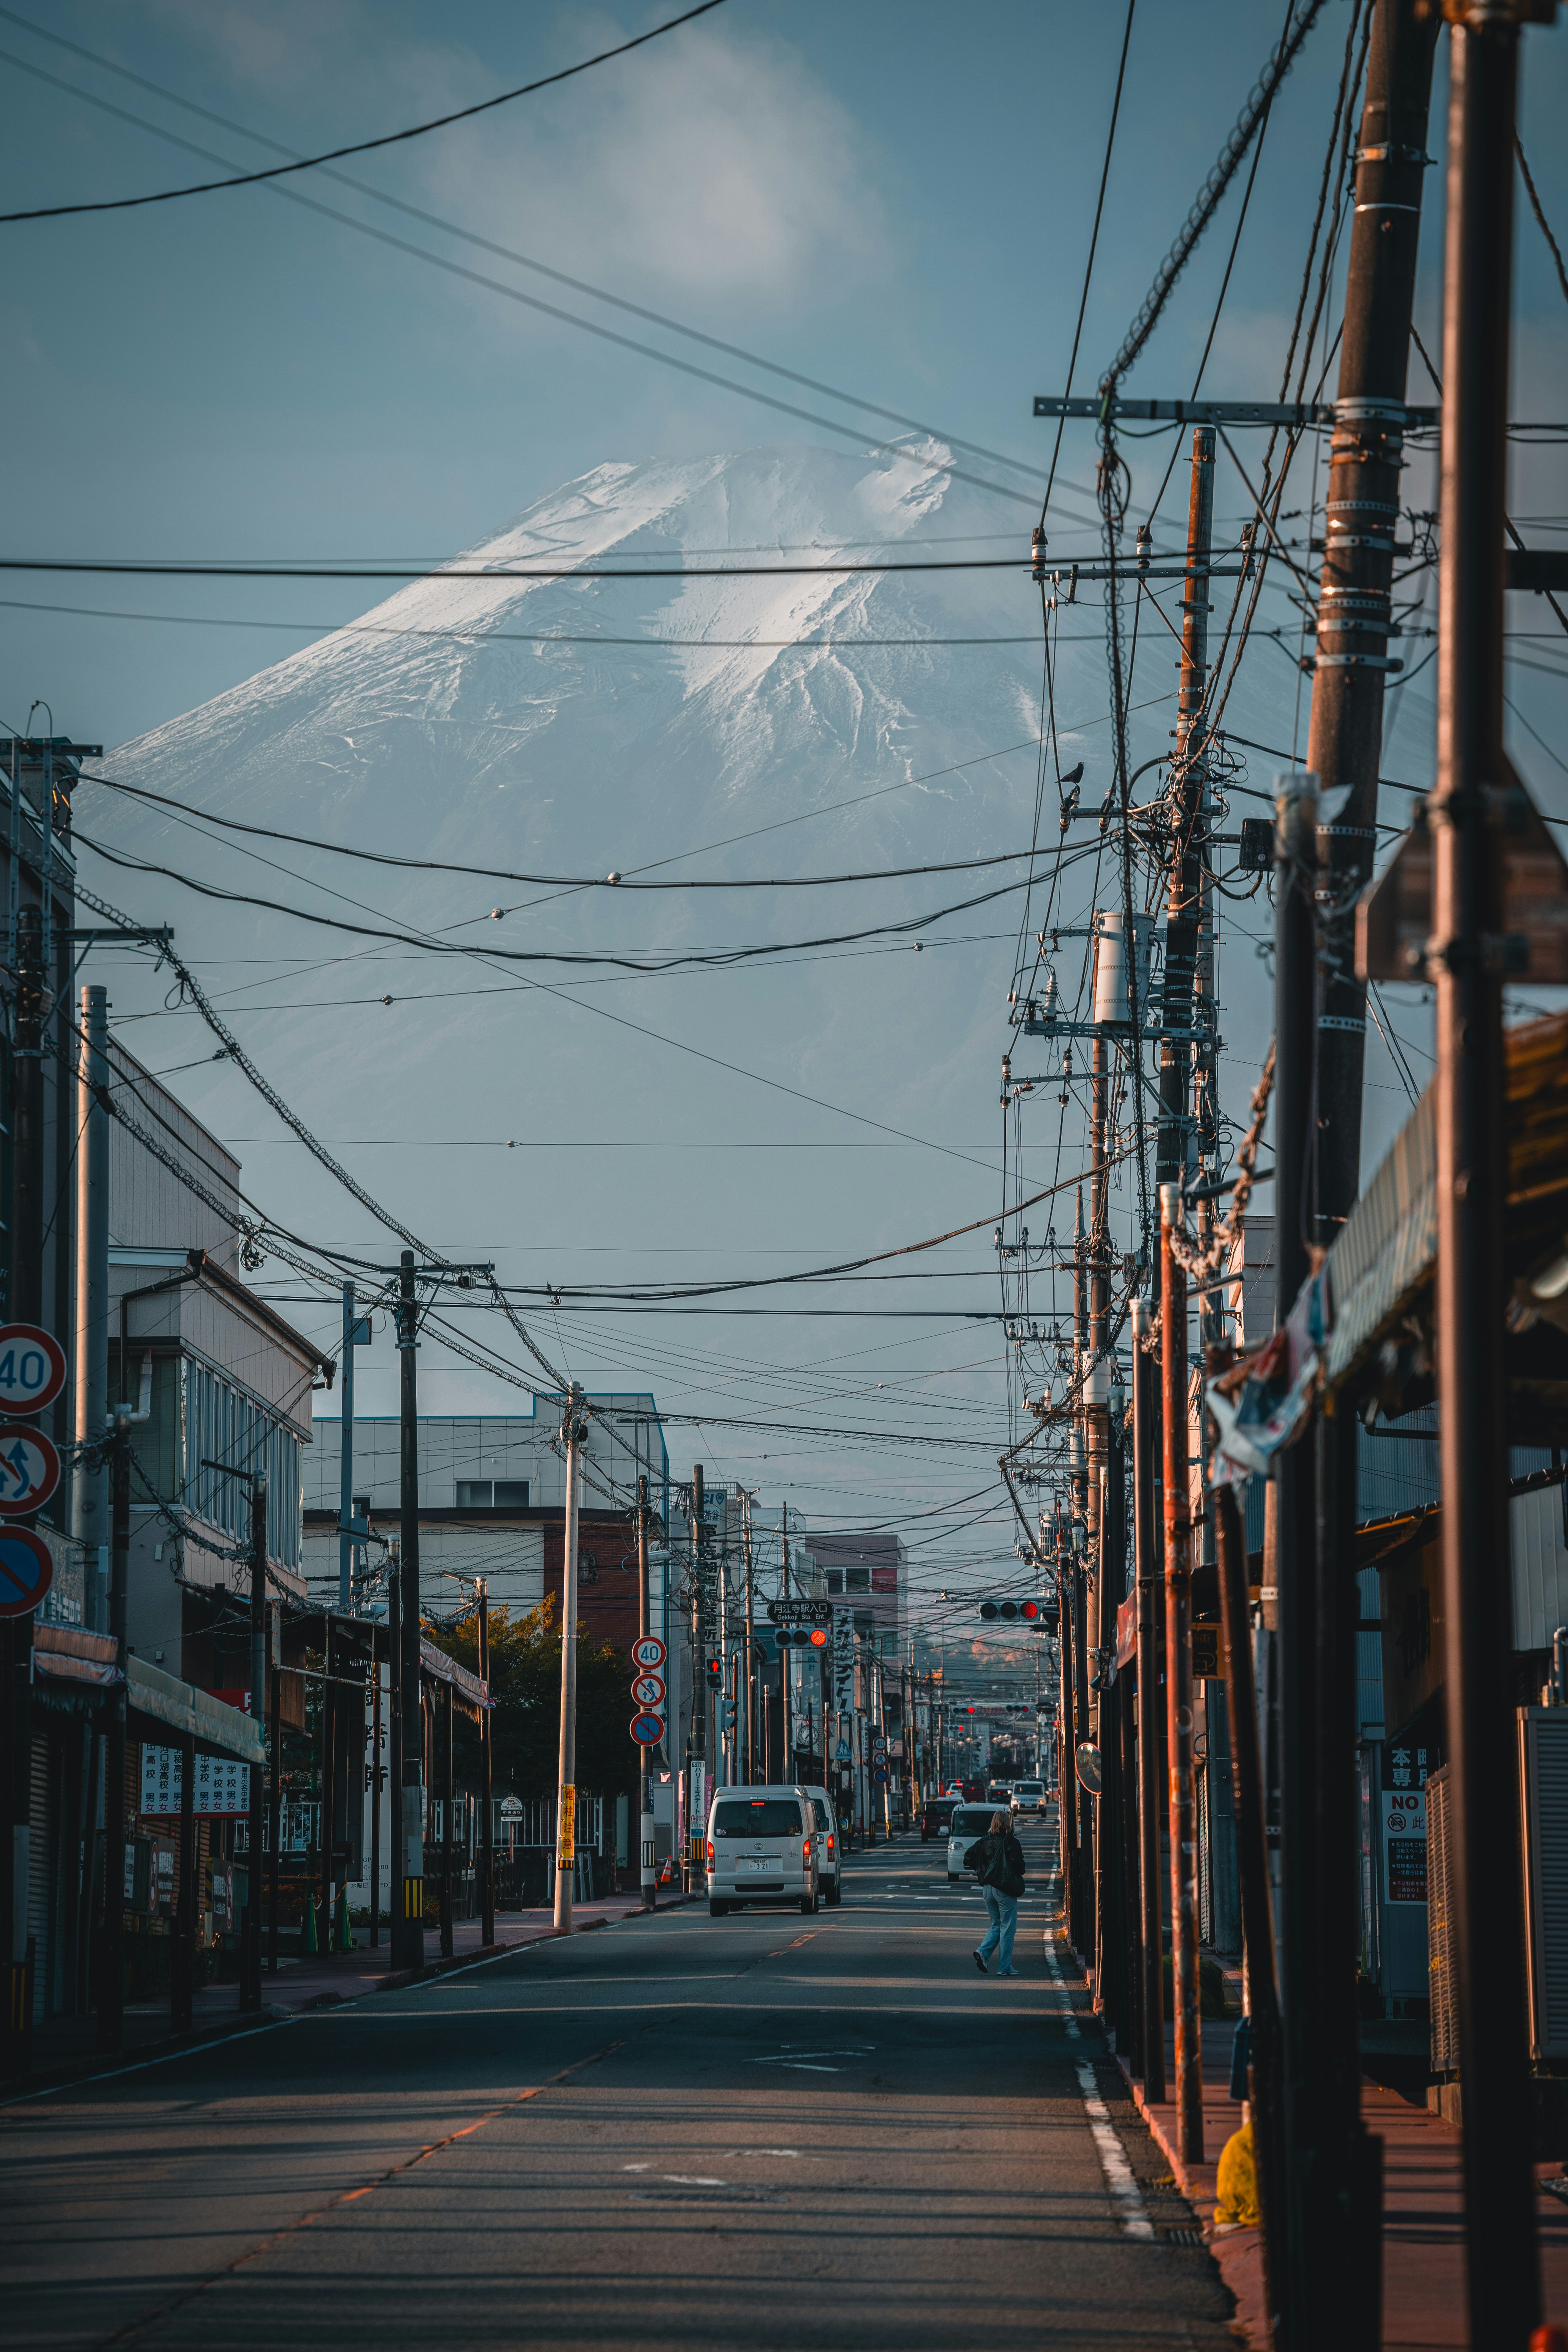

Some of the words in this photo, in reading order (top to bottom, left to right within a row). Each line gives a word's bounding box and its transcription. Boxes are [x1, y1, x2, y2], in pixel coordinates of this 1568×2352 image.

[0, 1350, 44, 1389] 40
[704, 1494, 714, 1504] CI
[774, 1604, 827, 1613] 月江寺駅入口
[641, 1646, 659, 1661] 40
[1392, 1796, 1419, 1810] NO
[563, 1789, 574, 1850] 電柱注意
